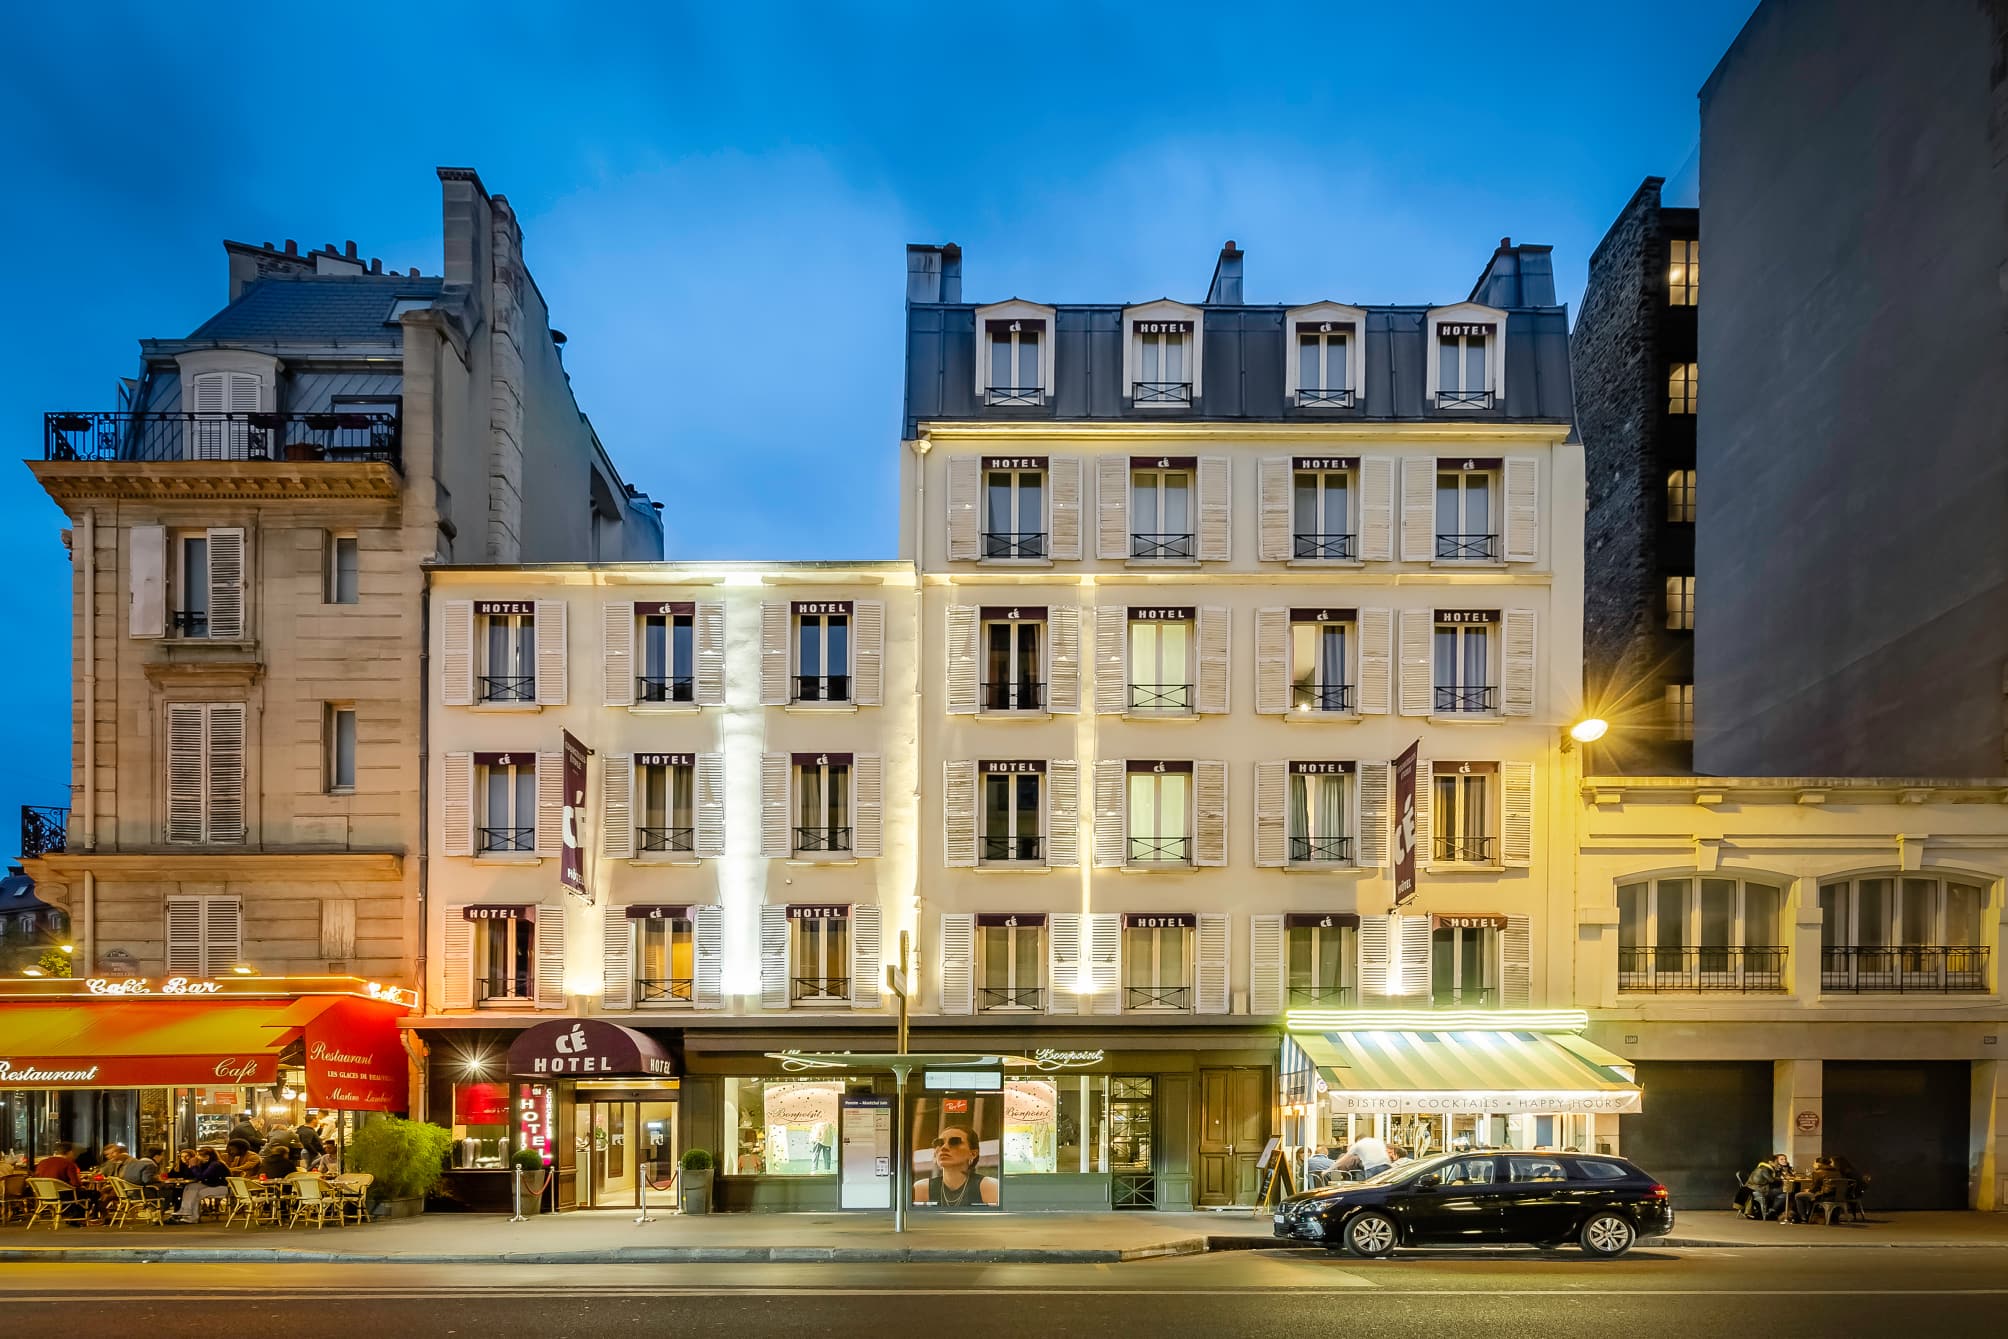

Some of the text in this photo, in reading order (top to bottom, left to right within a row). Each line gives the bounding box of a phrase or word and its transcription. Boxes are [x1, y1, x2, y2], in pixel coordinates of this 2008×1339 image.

[1140, 323, 1186, 333] HOTEL
[1442, 325, 1488, 335] HOTEL
[992, 459, 1038, 468] HOTEL
[1302, 460, 1348, 469] HOTEL
[482, 604, 529, 613] HOTEL
[799, 604, 845, 613] HOTEL
[1138, 610, 1184, 619] HOTEL
[1444, 612, 1489, 622] HOTEL
[642, 755, 689, 765] HOTEL
[989, 762, 1036, 772] HOTEL
[1299, 764, 1345, 773] HOTEL
[470, 909, 517, 919] HOTEL
[793, 908, 840, 918] HOTEL
[1138, 918, 1185, 928] HOTEL
[1451, 918, 1498, 928] HOTEL
[162, 977, 223, 994] Bar
[555, 1023, 588, 1054] CÉ
[310, 1041, 374, 1065] Restaurant
[534, 1056, 612, 1072] HOTEL
[1035, 1048, 1105, 1071] Bonpoint
[213, 1057, 258, 1084] Café
[650, 1058, 671, 1074] HOTEL
[1348, 1098, 1623, 1109] BISTRO COCKTAILS HAPPY HOURS
[767, 1107, 823, 1125] Bonpoint
[520, 1098, 554, 1159] HOTEL
